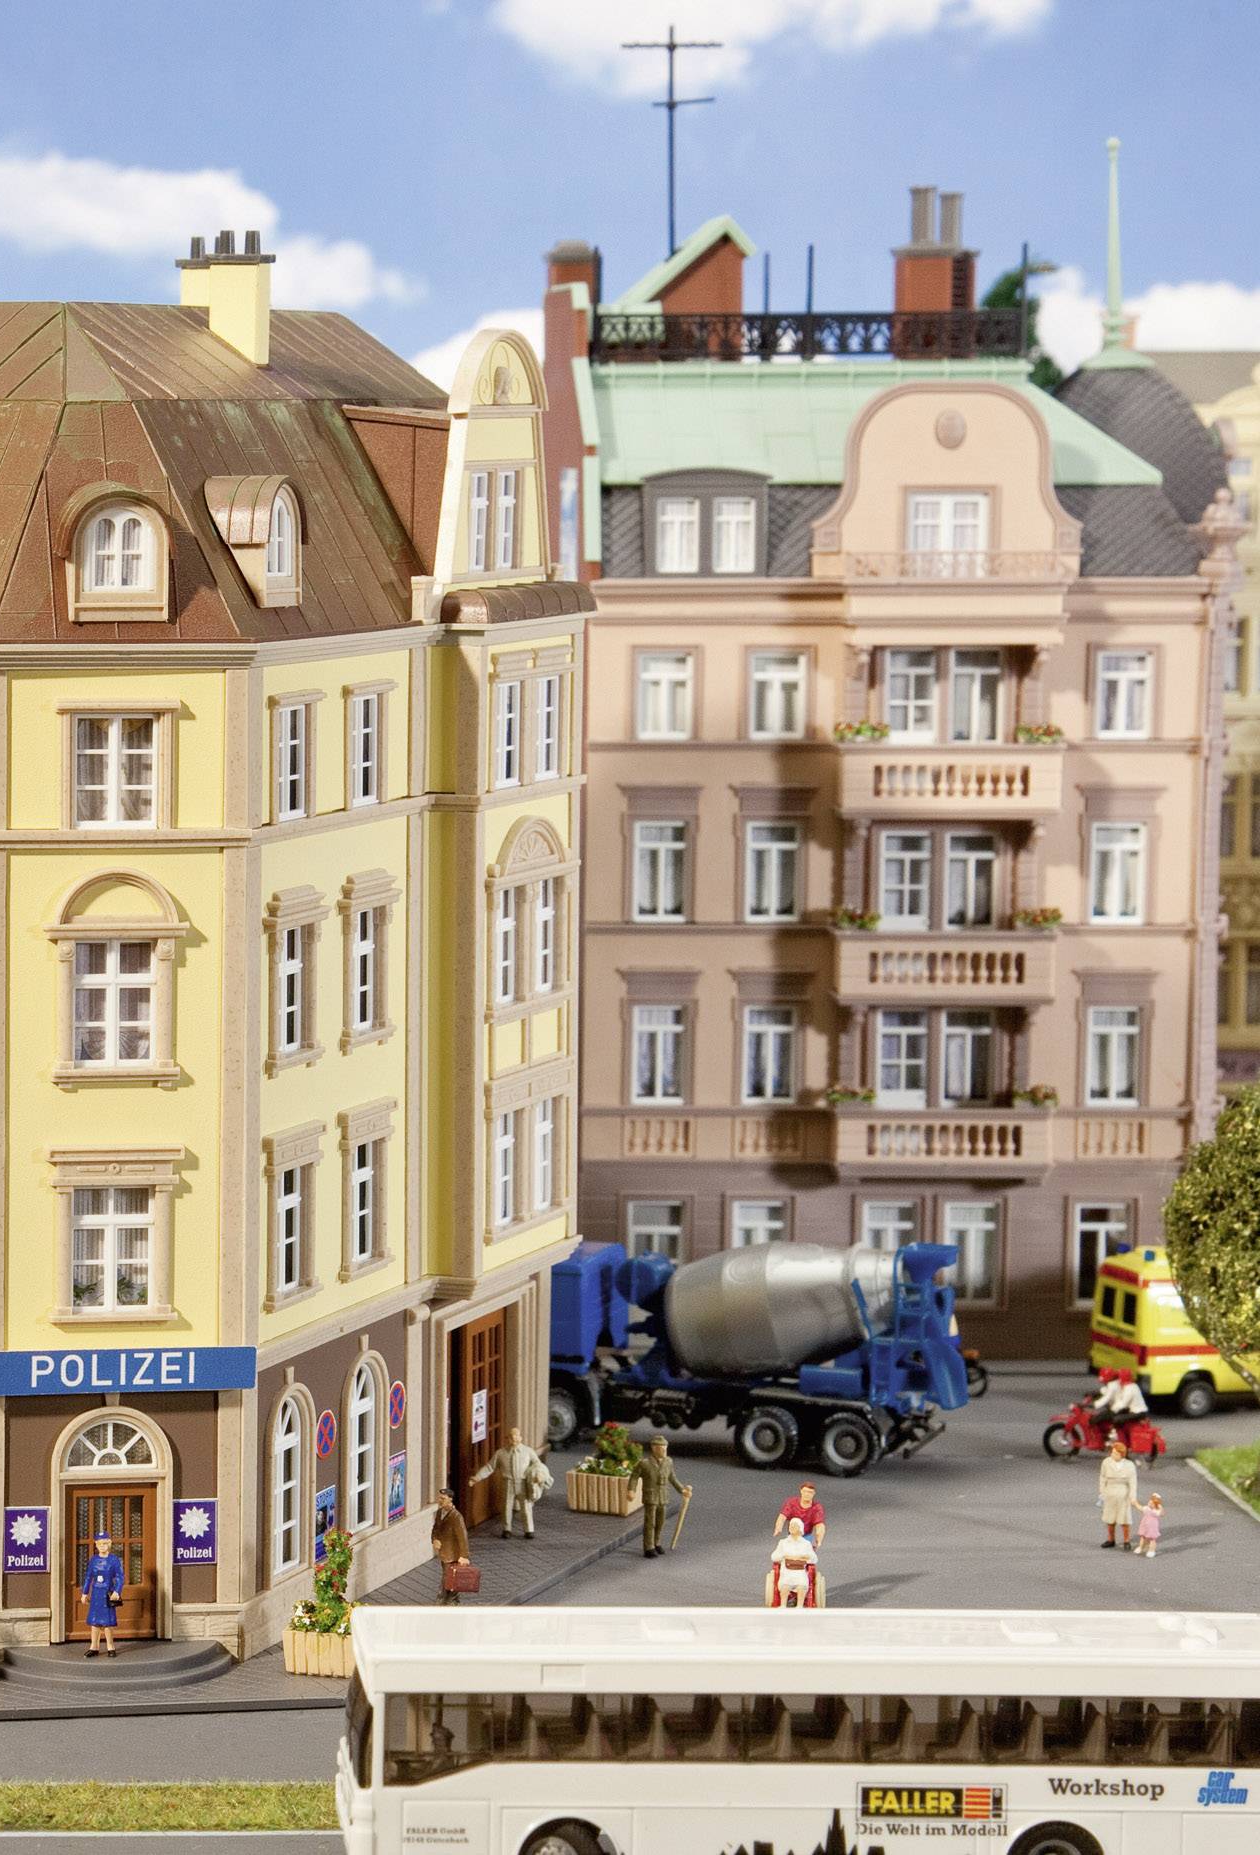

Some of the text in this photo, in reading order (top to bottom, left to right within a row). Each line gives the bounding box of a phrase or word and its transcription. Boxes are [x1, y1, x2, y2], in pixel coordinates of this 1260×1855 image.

[31, 1351, 195, 1388] POLIZEI
[7, 1554, 44, 1567] Polizei
[176, 1547, 213, 1559] Polizei
[1048, 1777, 1165, 1801] Workshop
[1207, 1771, 1235, 1789] car
[868, 1790, 956, 1814] FALLER
[1197, 1787, 1248, 1807] system
[406, 1827, 438, 1835] FALLER
[856, 1823, 1008, 1837] Die Welt im Modell
